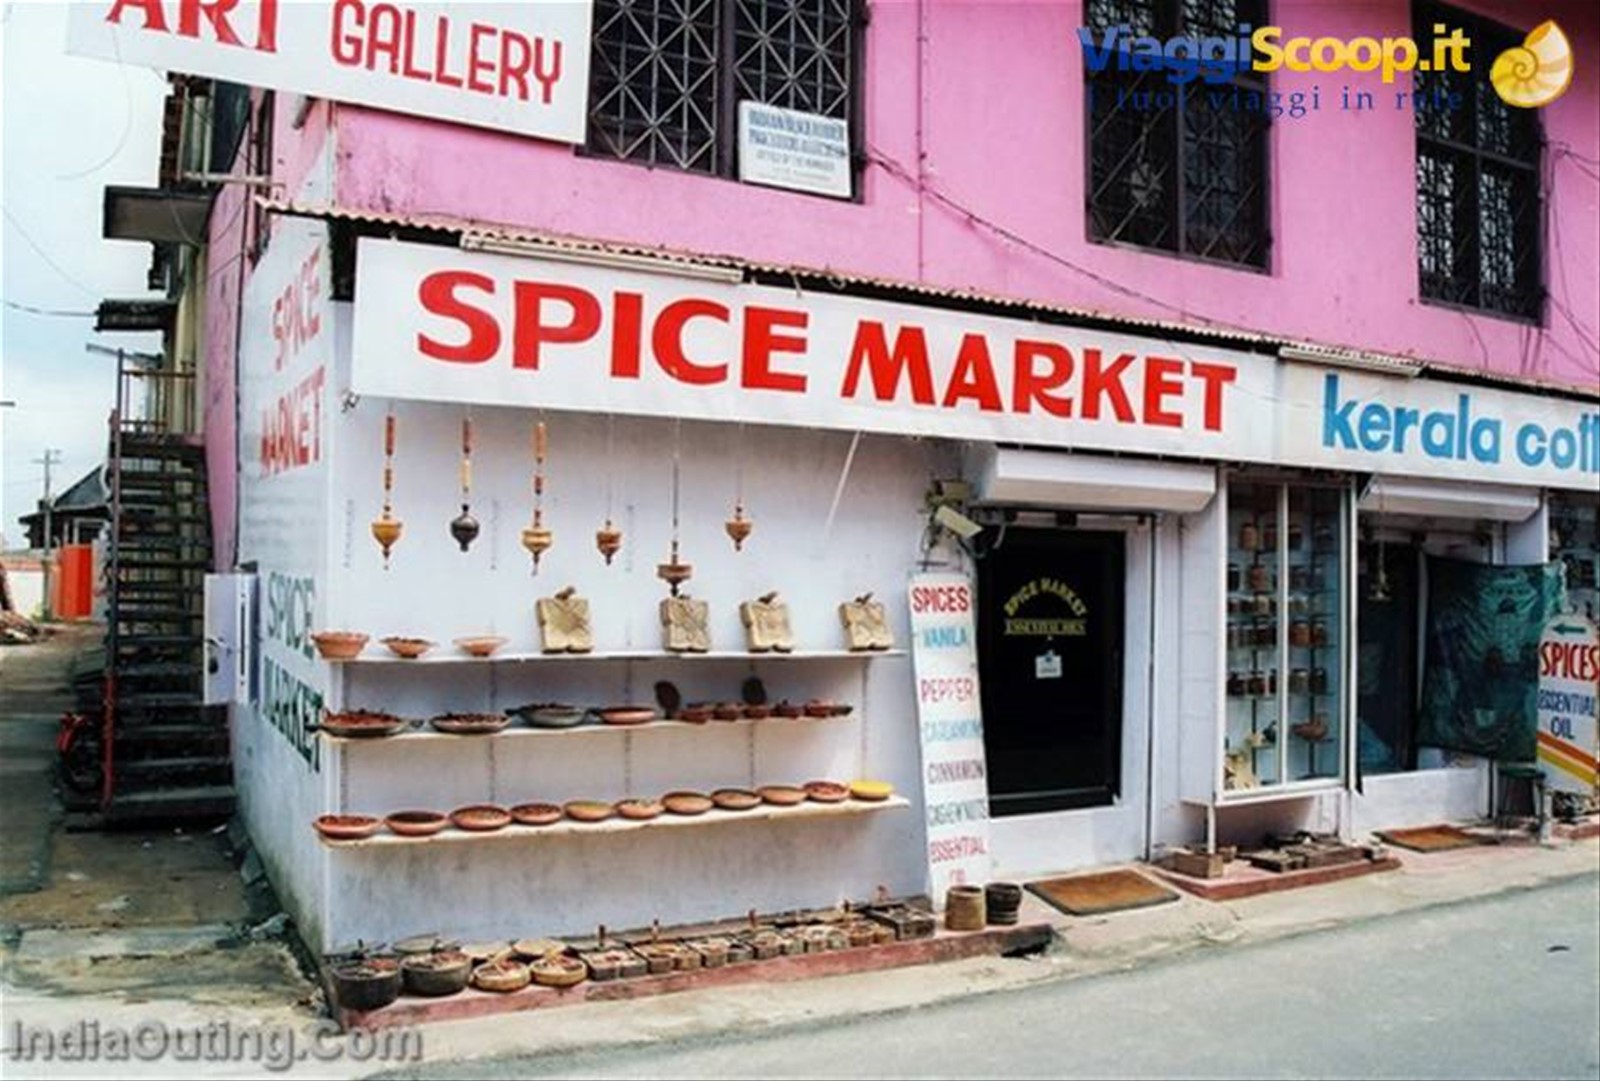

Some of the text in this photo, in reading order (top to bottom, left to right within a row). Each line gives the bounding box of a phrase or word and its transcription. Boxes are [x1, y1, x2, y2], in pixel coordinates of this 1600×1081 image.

[331, 0, 564, 105] GALLERY
[417, 271, 1237, 432] SPICE MARKET
[1323, 373, 1501, 463] kerala
[912, 586, 969, 612] SPICES
[1540, 642, 1599, 682] SPICES
[921, 678, 974, 703] PEPPER
[1537, 689, 1595, 717] ESSENTIAL
[1550, 716, 1576, 740] OIL
